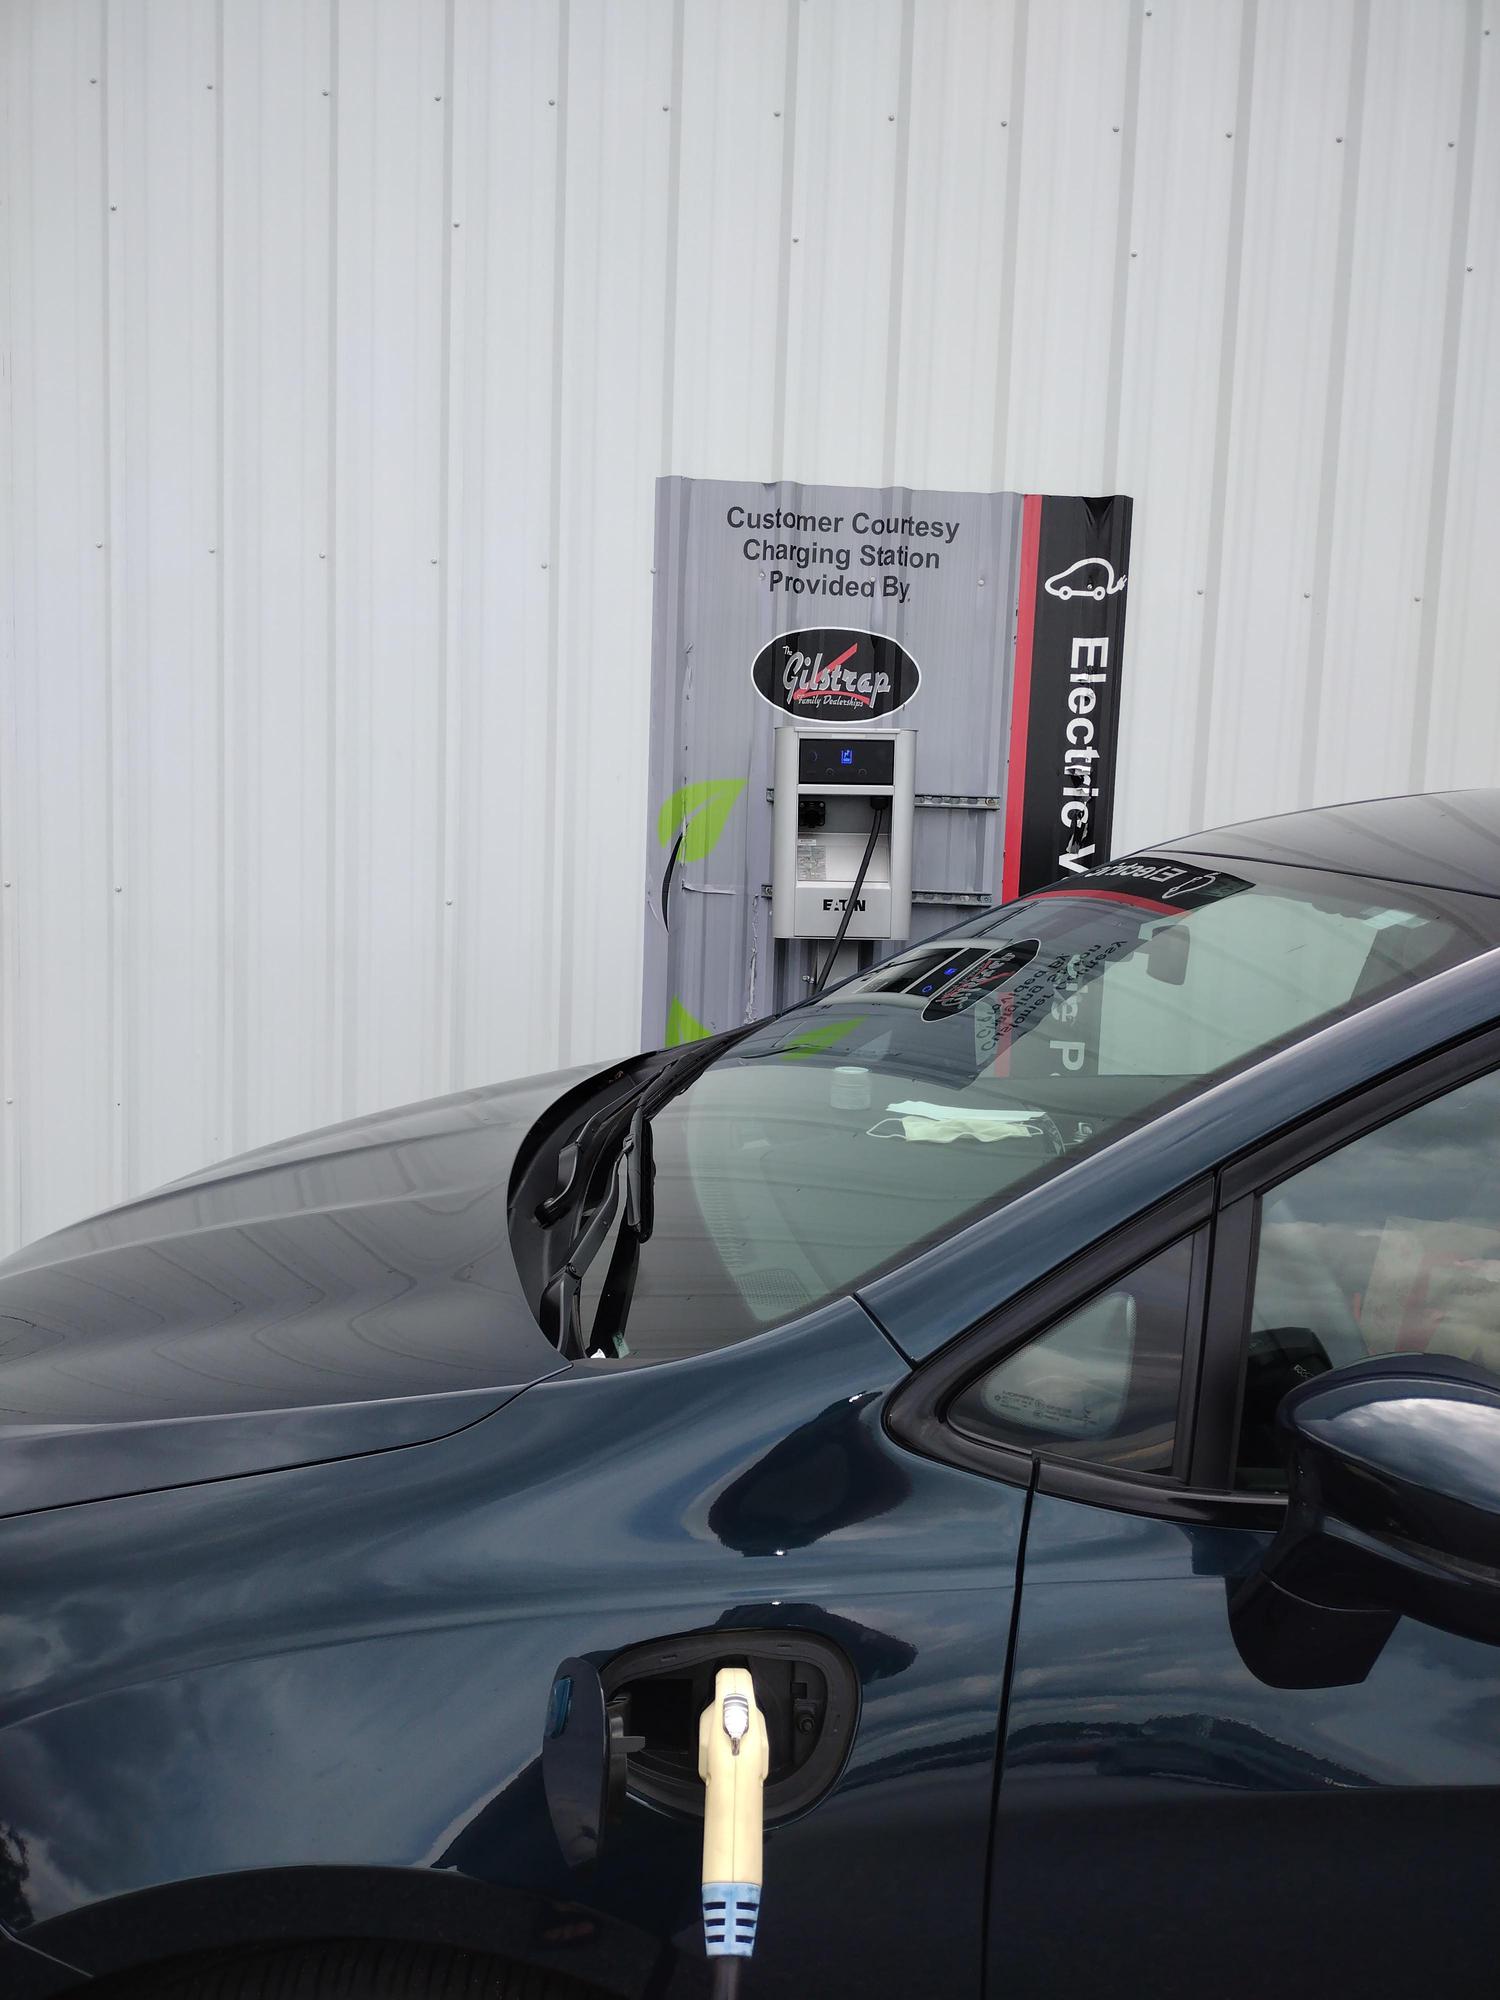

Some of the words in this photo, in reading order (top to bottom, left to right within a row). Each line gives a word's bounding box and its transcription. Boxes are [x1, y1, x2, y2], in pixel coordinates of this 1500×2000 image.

[727, 506, 844, 533] Customer
[852, 512, 960, 543] Courtesy
[743, 539, 850, 570] Charging
[860, 545, 940, 568] Station
[769, 570, 875, 597] Provided
[783, 645, 793, 656] The
[783, 652, 891, 709] Gilstrap
[797, 694, 821, 708] Family
[823, 695, 864, 709] Dealerships
[1060, 637, 1109, 828] Electric
